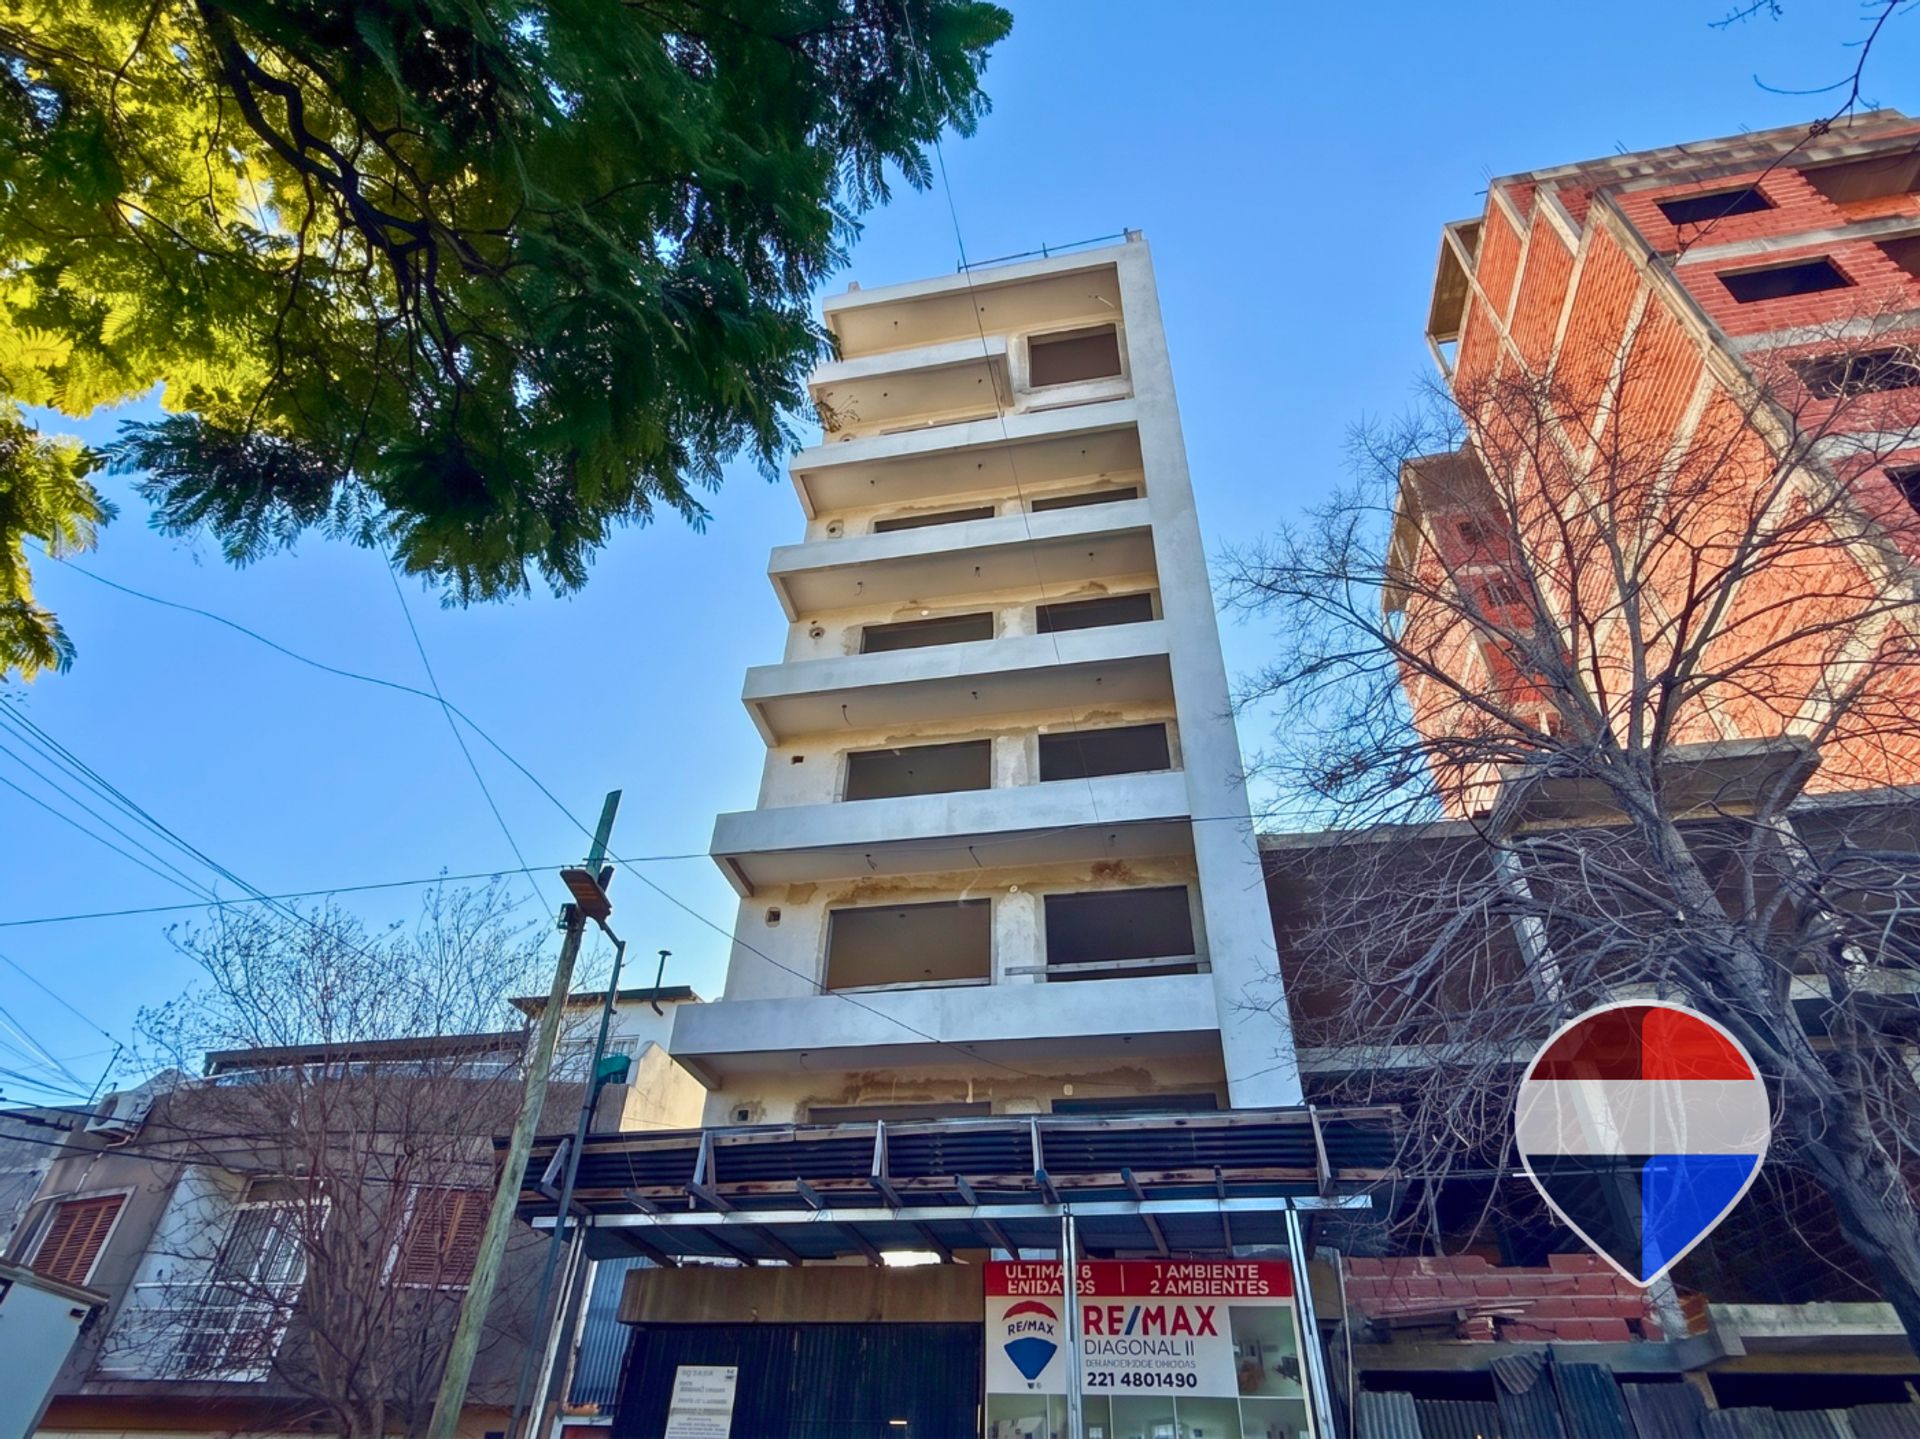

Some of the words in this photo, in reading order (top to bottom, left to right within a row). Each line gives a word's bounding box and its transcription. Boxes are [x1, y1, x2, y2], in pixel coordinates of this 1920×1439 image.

[1081, 1264, 1092, 1279] 6
[1154, 1264, 1162, 1279] 1
[1166, 1264, 1259, 1279] AMBIENTE
[1150, 1279, 1160, 1294] 2
[1164, 1279, 1270, 1295] AMBIENTES
[1008, 1320, 1055, 1336] RE/MAX
[1083, 1305, 1218, 1337] RE/MAX
[1084, 1339, 1181, 1356] DIAGONAL
[1184, 1340, 1195, 1356] II
[1087, 1371, 1115, 1387] 221
[1120, 1372, 1198, 1388] 4801490
